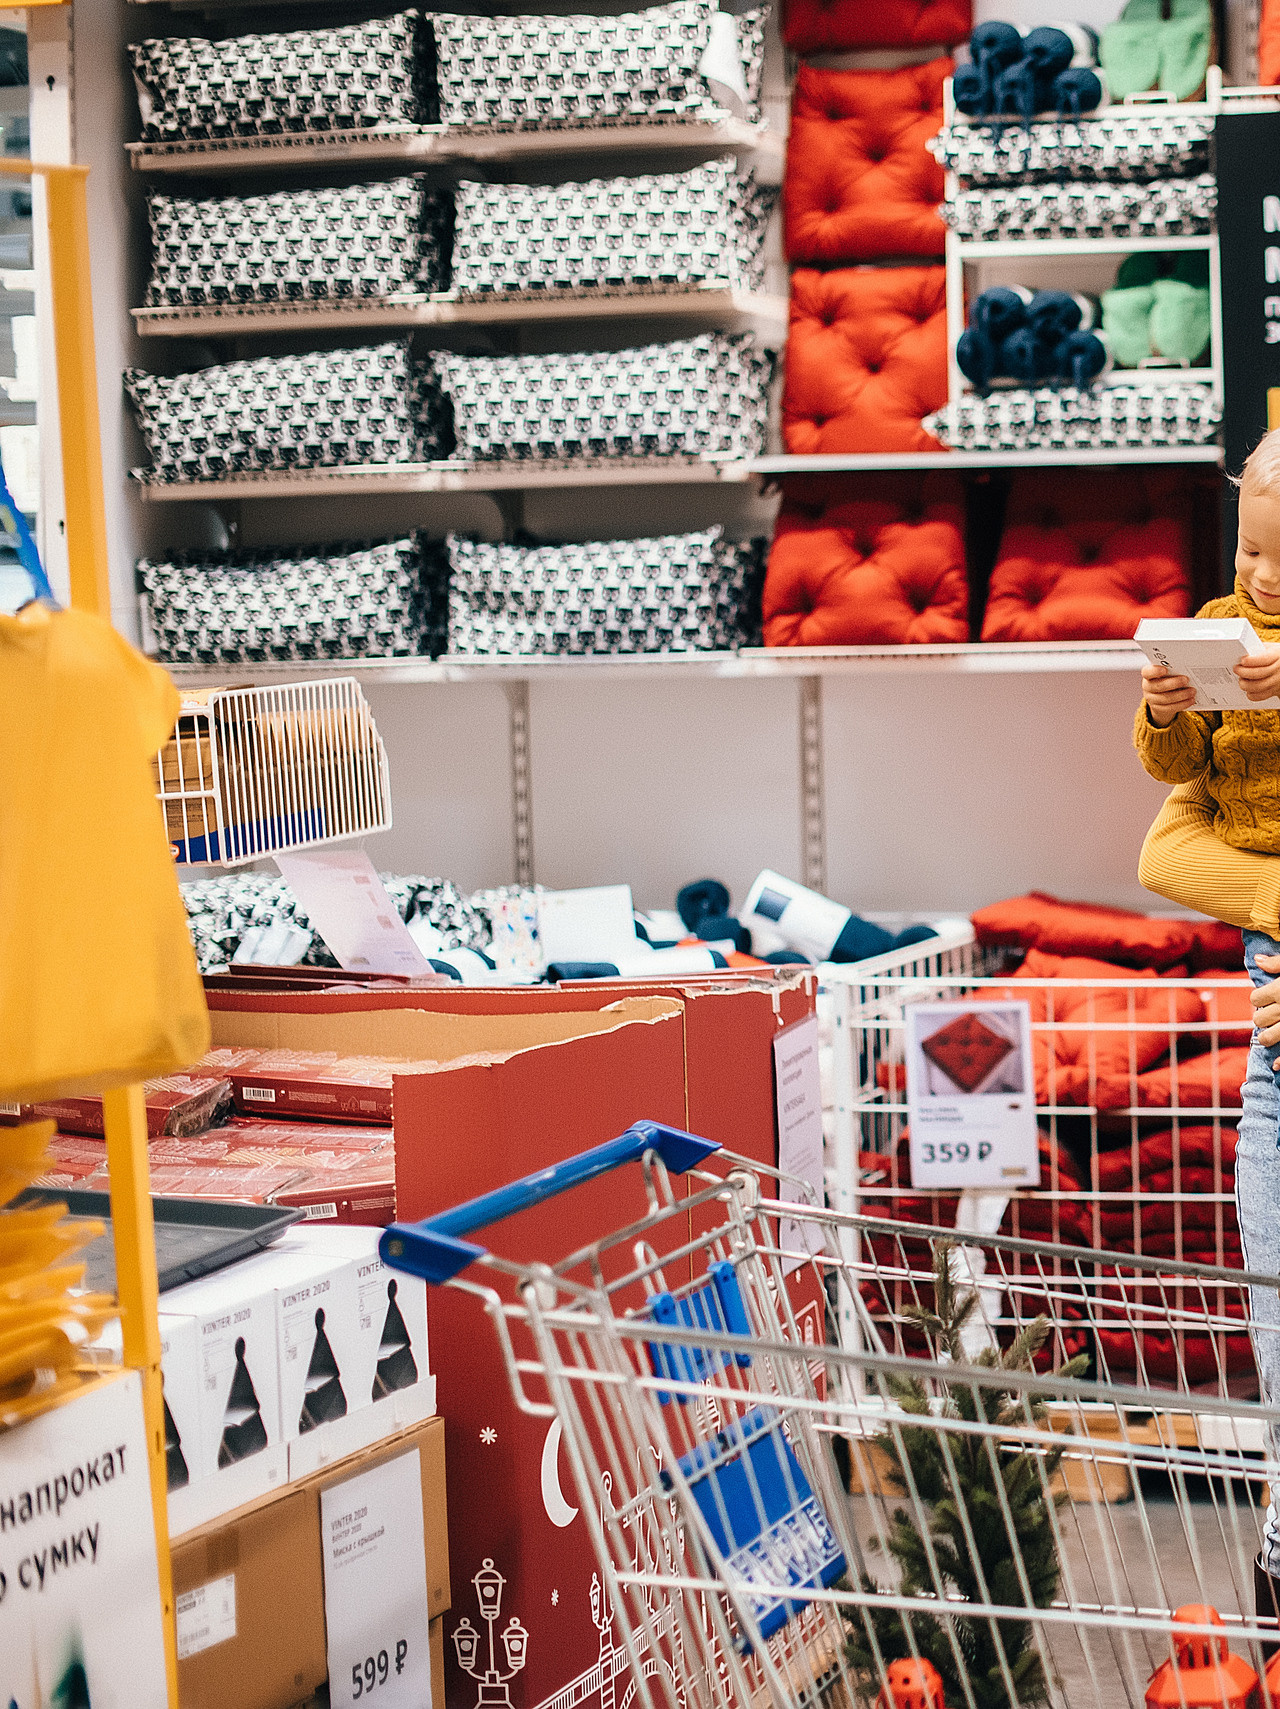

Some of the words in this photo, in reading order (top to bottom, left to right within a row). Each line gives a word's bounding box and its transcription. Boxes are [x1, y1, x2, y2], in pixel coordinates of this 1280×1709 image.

[921, 1142, 970, 1164] 359
[356, 1260, 385, 1278] VINTER
[0, 1444, 127, 1532] напрокат
[18, 1521, 100, 1592] сумку
[352, 1650, 389, 1700] 599
[395, 1639, 408, 1675] ₽
